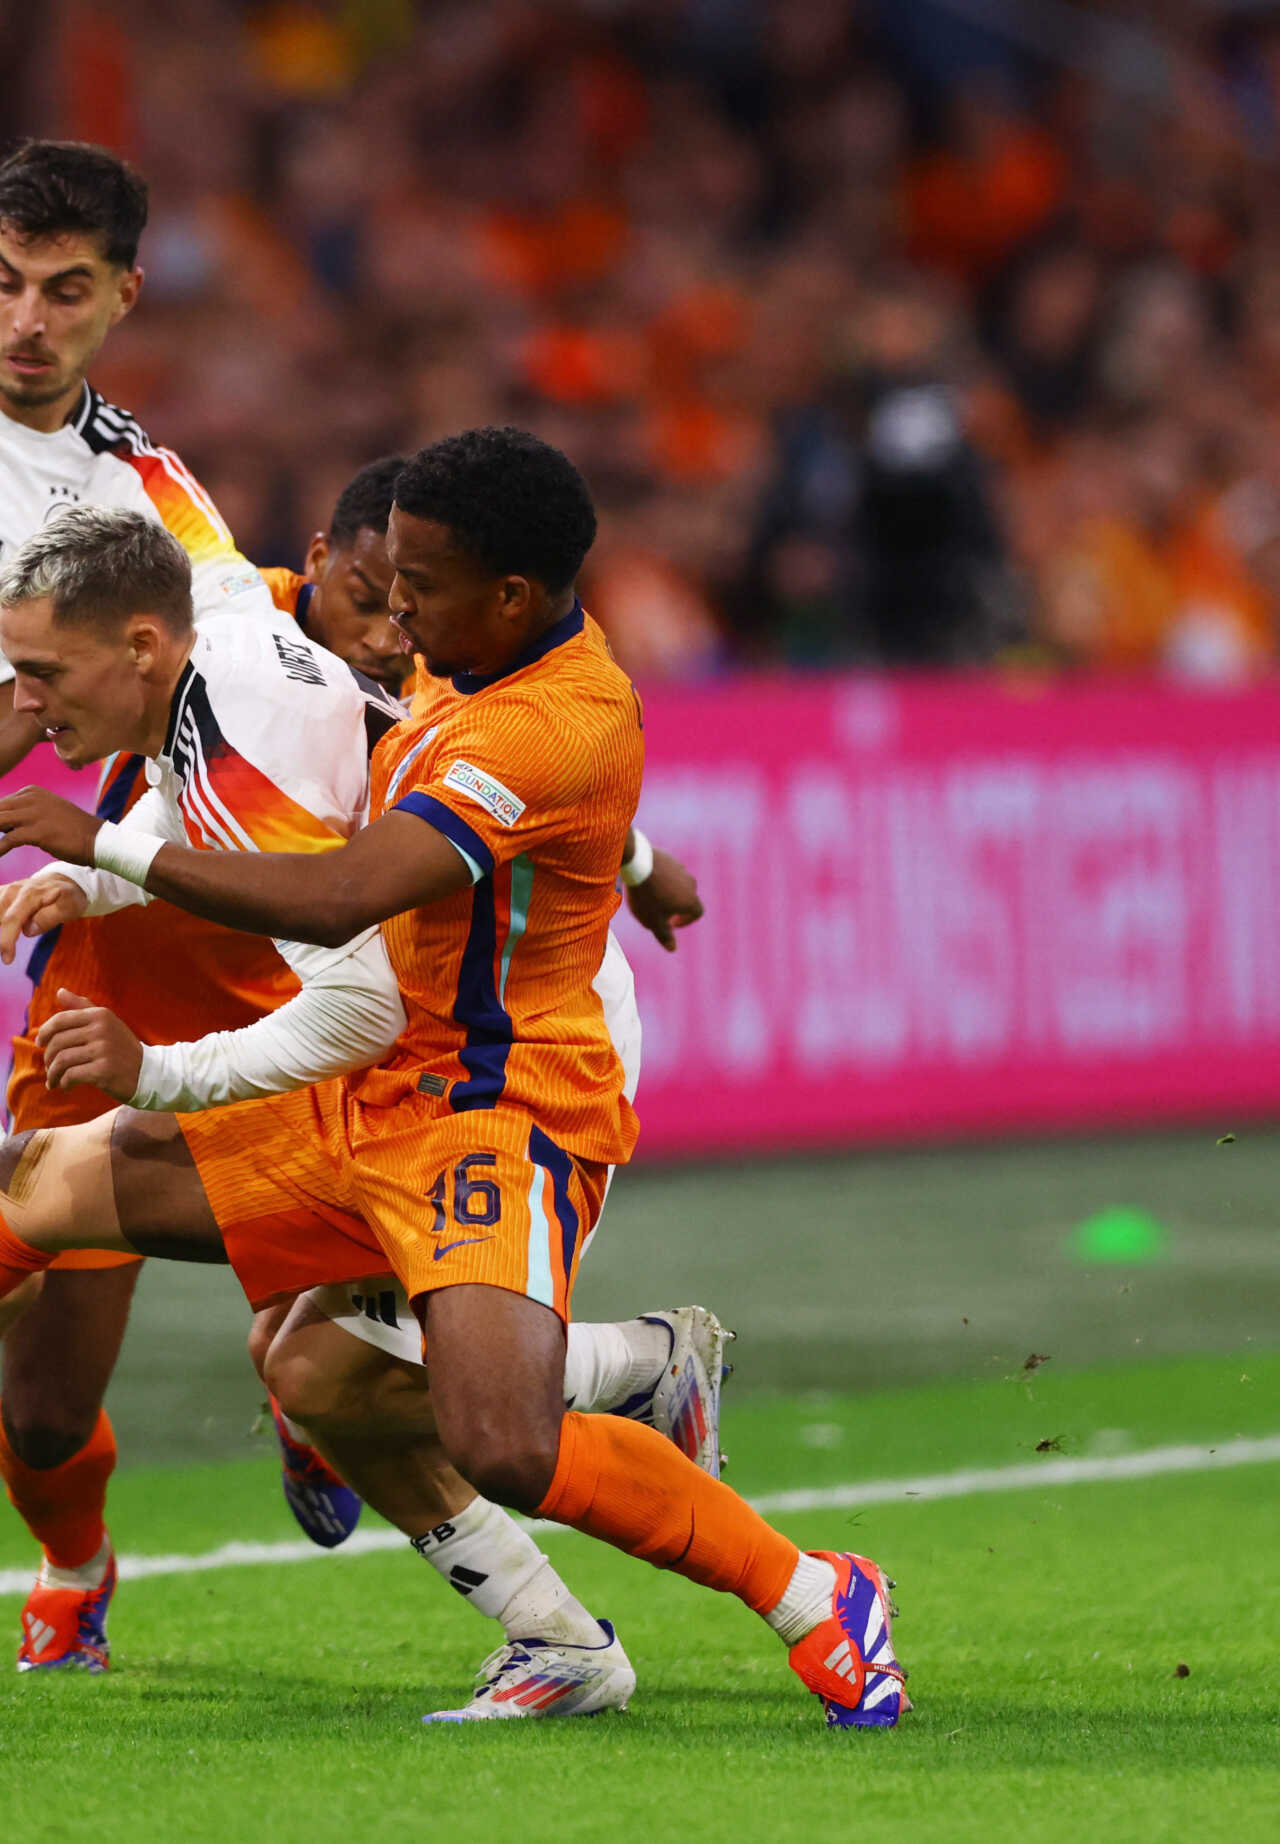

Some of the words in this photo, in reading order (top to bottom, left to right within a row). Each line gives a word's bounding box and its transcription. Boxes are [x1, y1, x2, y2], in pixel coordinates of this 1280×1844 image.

[272, 633, 328, 687] WIRTZ
[450, 767, 519, 820] FOUNDATION
[423, 1152, 501, 1232] 16
